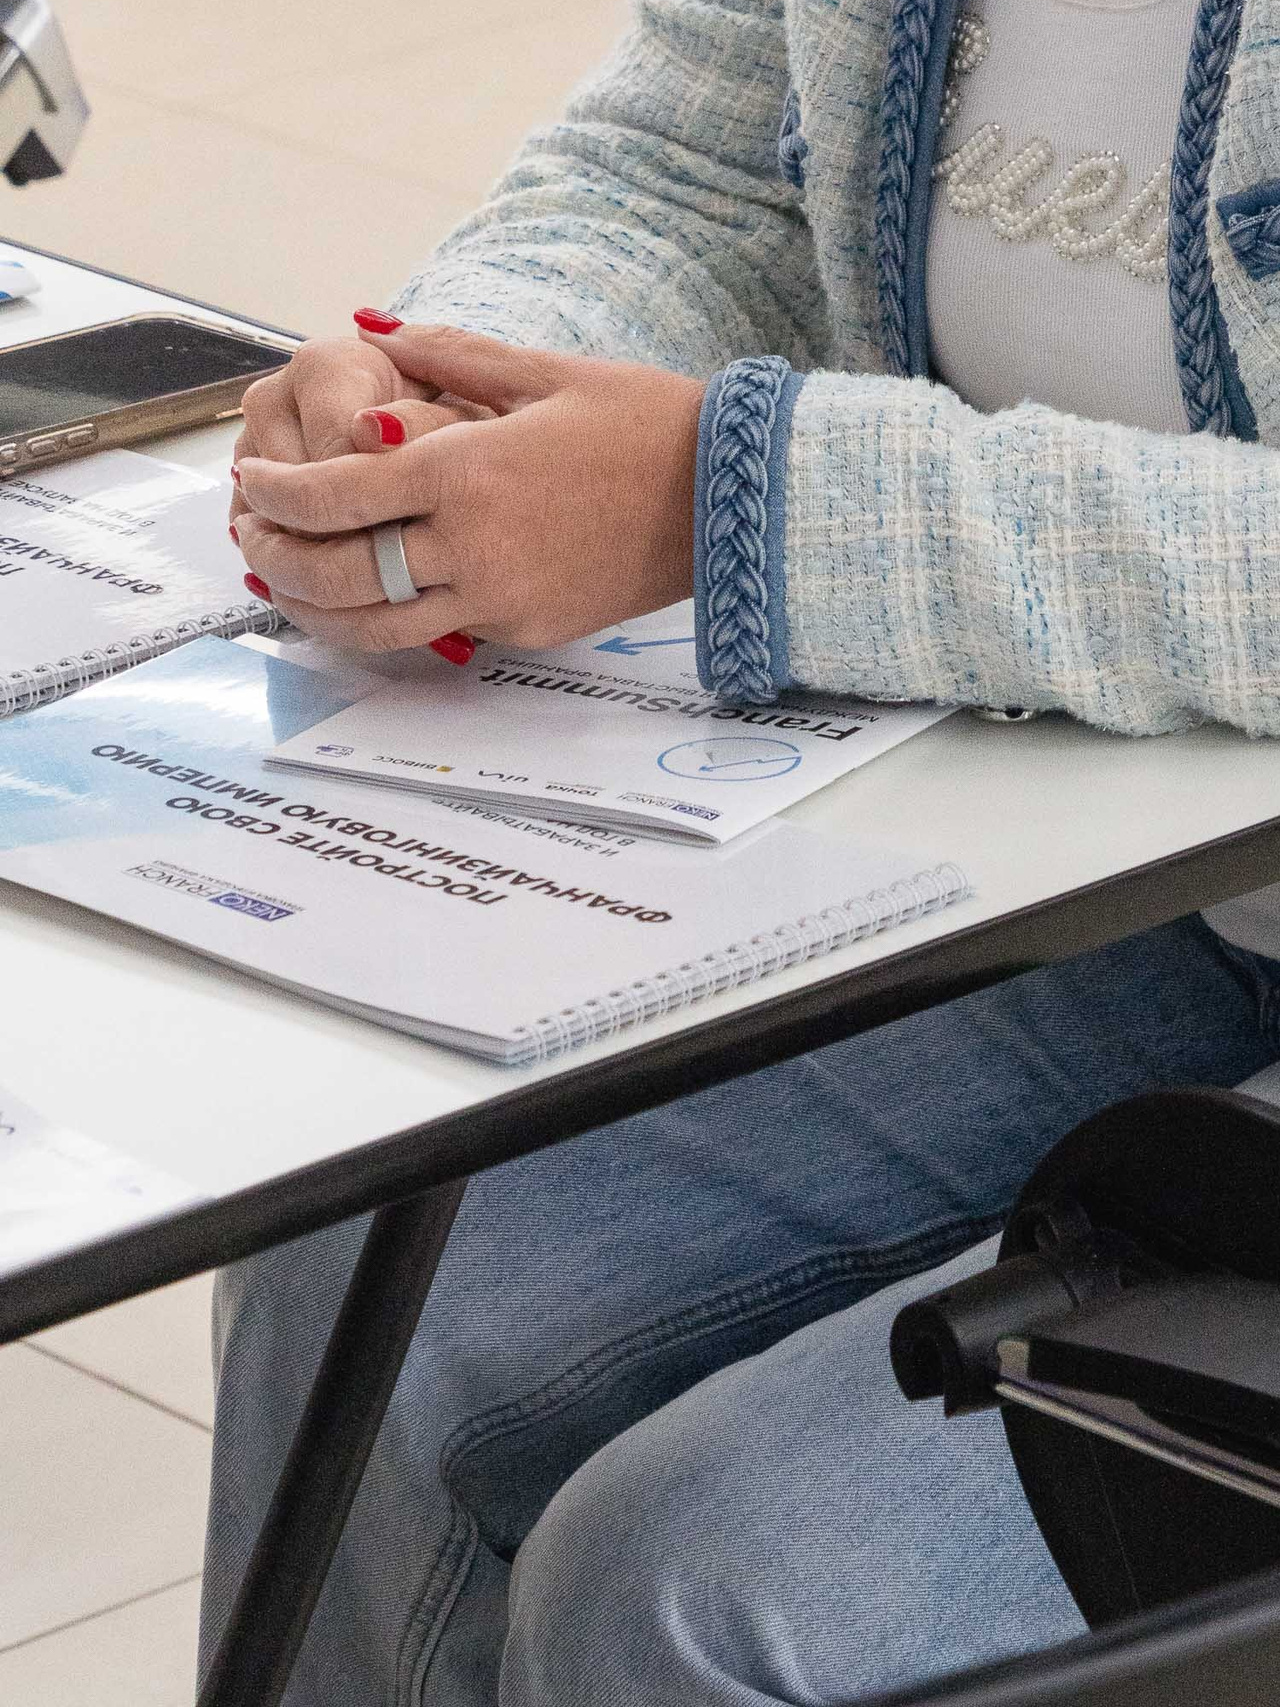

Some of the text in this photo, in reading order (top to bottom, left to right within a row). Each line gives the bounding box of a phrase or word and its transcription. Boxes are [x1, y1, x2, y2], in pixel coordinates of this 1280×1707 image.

[478, 669, 863, 742] FranchSummit
[91, 744, 285, 808] ИМПЕРИЮ
[165, 797, 281, 834] СВОЮ
[125, 863, 222, 899] FRANCH
[277, 831, 508, 905] ПОСТРОЙТЕ
[280, 804, 672, 923] ФРАНЧАЙЗИНГОВУЮ
[209, 891, 294, 922] NEKO
